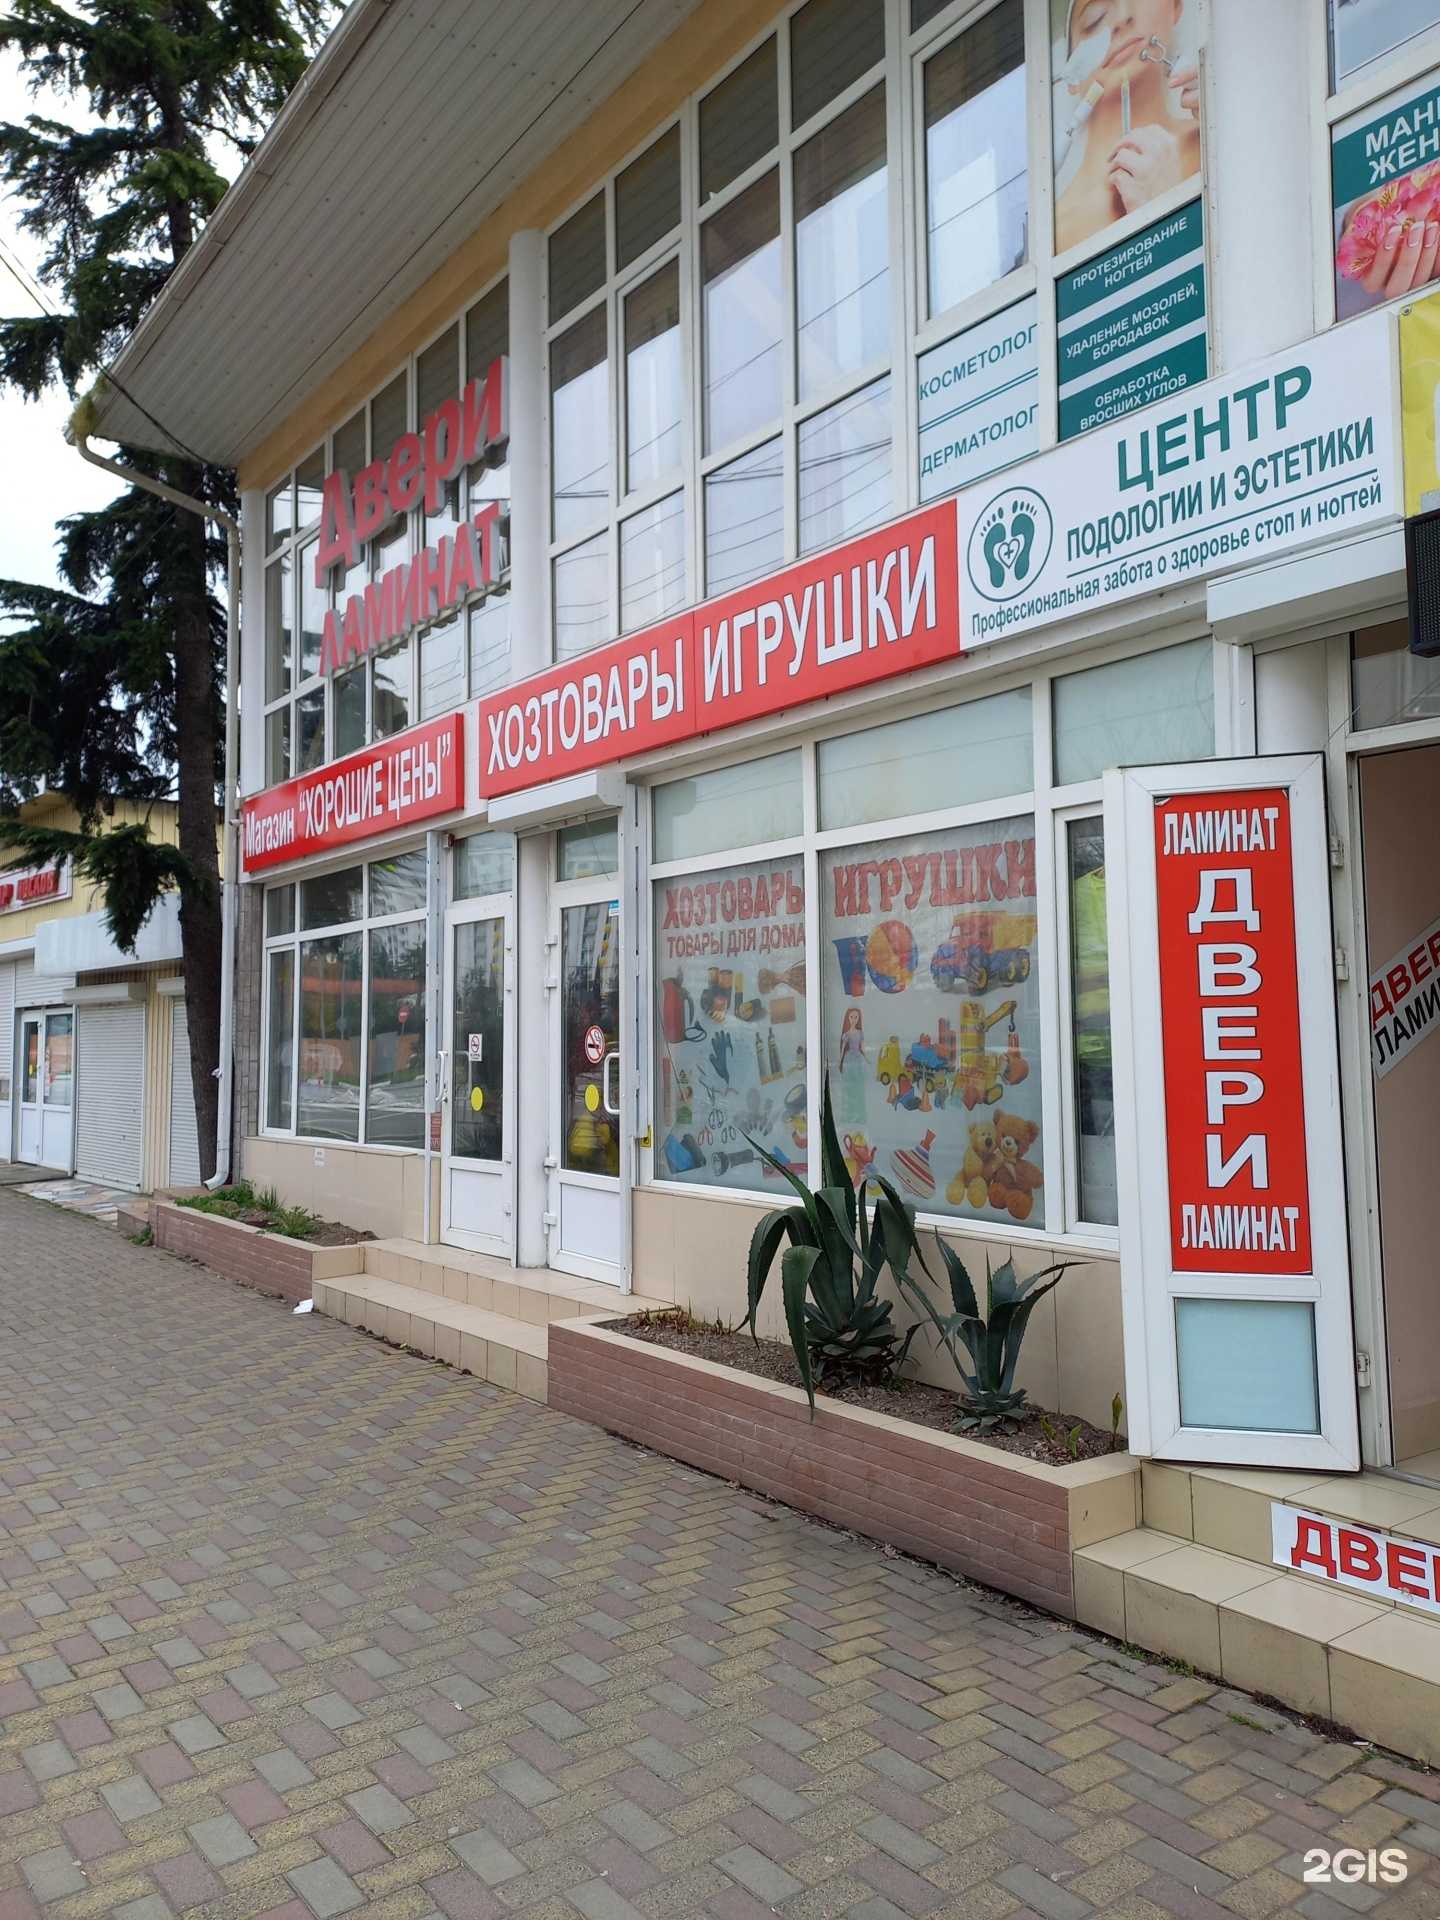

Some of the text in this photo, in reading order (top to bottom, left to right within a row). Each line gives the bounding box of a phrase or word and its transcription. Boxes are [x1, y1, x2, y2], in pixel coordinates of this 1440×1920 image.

[1366, 96, 1440, 157] МАН
[1072, 217, 1188, 290] ПРОТЕЗИРОВАНИЕ
[1104, 251, 1153, 288] НОГТЕЙ
[1066, 283, 1198, 359] УДАЛЕНИЕ МОЗОЛЕЙ,
[1092, 312, 1170, 360] БОРОДАВОК
[919, 323, 1038, 400] КОСМЕТОЛОГ
[1095, 365, 1170, 408] ОБРАБОТКА
[1080, 373, 1187, 430] ВРОСШИХ УГЛОВ
[1117, 365, 1312, 492] ЦЕНТР
[921, 402, 1039, 477] ДЕРМАТОЛОГ
[1067, 416, 1374, 562] ПОДОЛОГИИ И ЭСТЕТИКИ
[319, 501, 506, 677] ЛАМИНАТ
[971, 475, 1382, 638] Профессиональная забота о здоровье стоп и ногтей
[487, 535, 938, 775] ХОЗТОВАРЫ ИГРУШКИ
[245, 808, 295, 858] Магазин
[1163, 806, 1280, 856] ЛАМИНАТ
[832, 838, 1038, 918] ИГРУШКИ
[667, 922, 806, 959] ТОВАРЫ ДЛЯ ДОМА
[1187, 867, 1270, 1190] ДВЕРИ
[1374, 976, 1440, 1065] ЛАМИ
[1181, 1204, 1299, 1253] ЛАМИНАТ
[1291, 1516, 1440, 1603] ДВЕ
